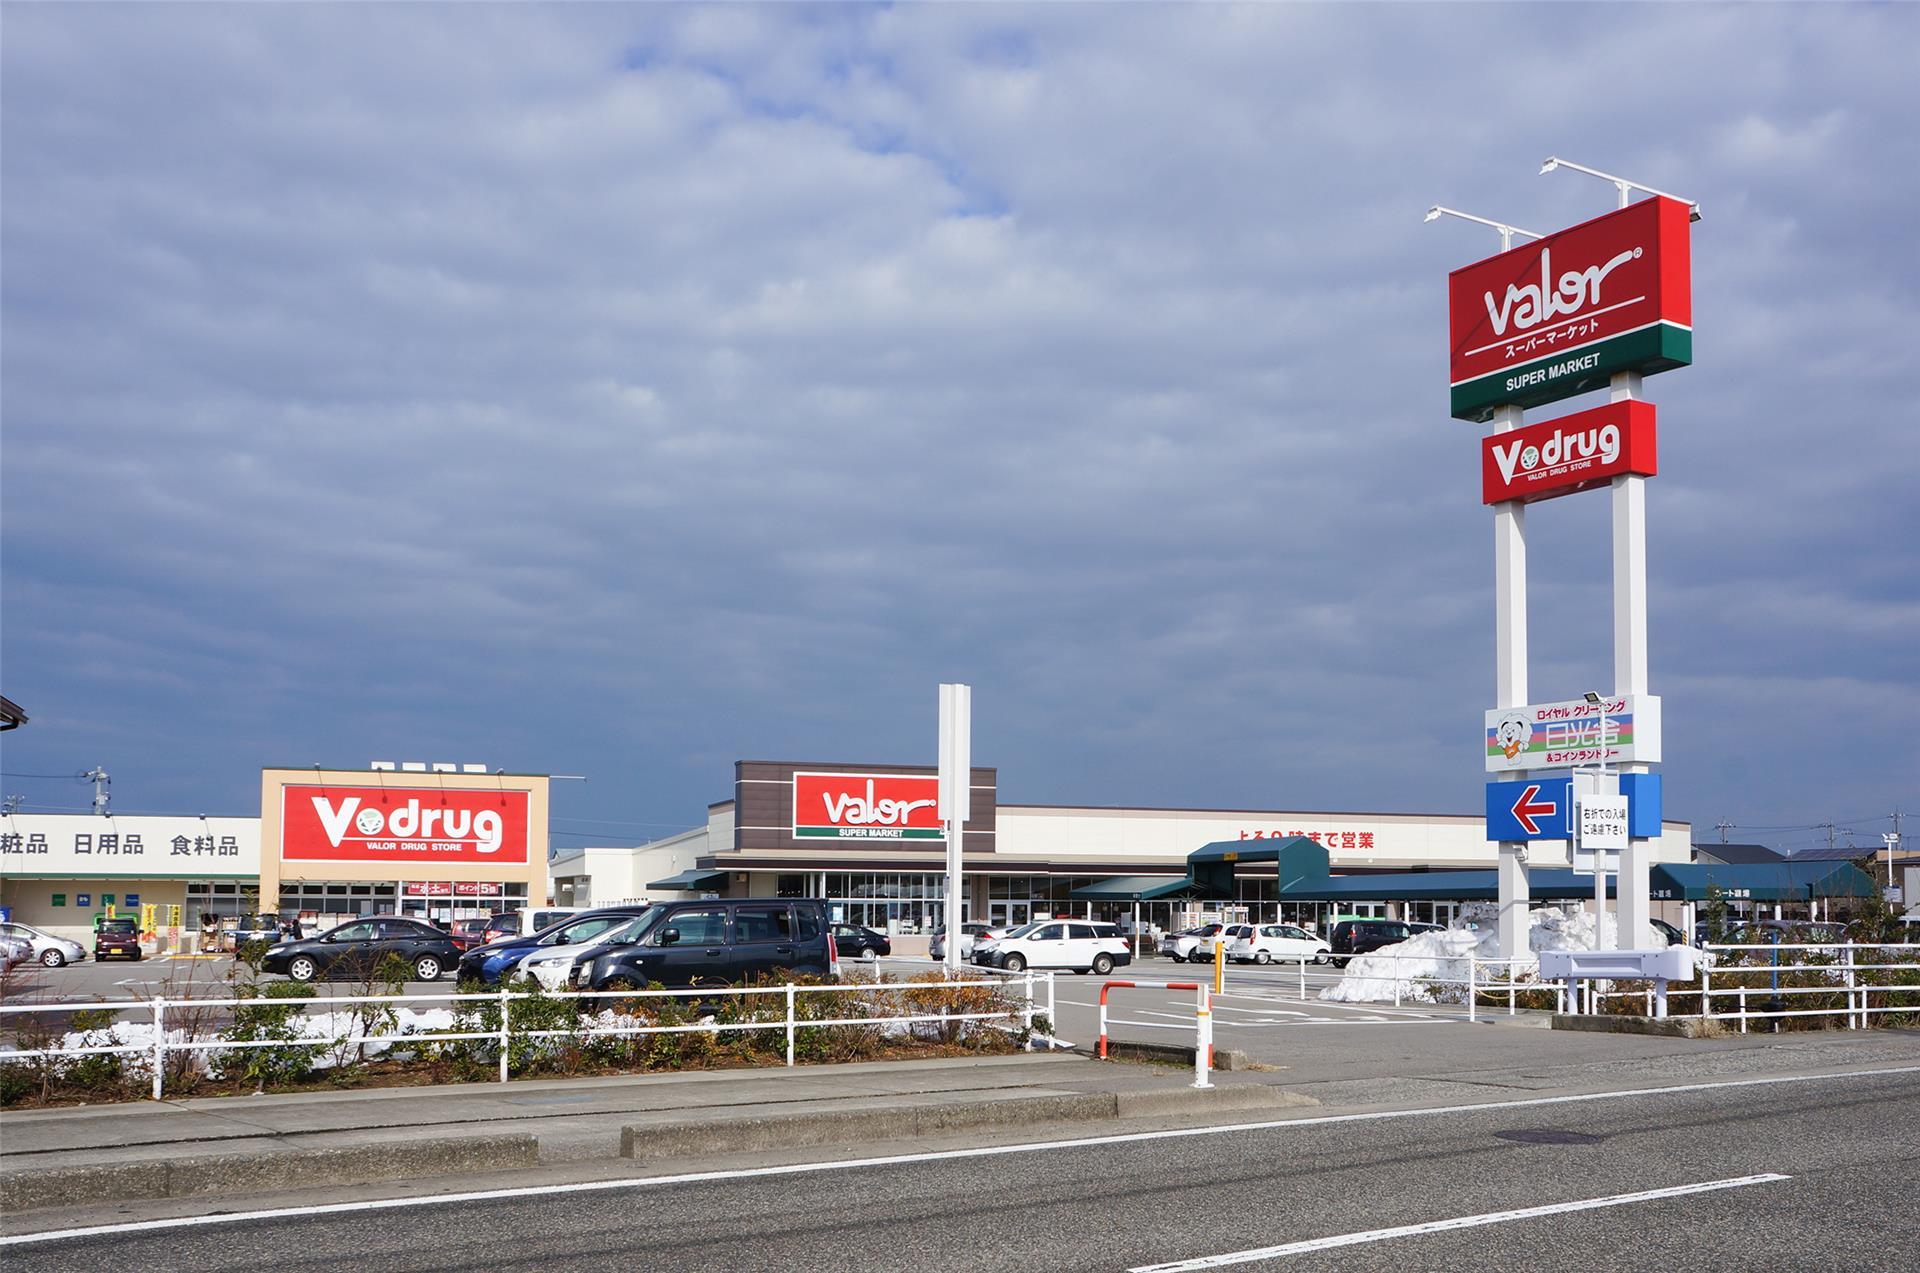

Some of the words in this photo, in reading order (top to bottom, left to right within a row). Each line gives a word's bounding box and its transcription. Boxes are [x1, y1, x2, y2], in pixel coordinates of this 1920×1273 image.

[1505, 317, 1599, 358] スーパーマーケット
[1506, 369, 1546, 392] SUPER
[1548, 353, 1601, 383] MARKET
[1527, 471, 1548, 481] VALOR
[1550, 466, 1568, 477] DRUG
[1570, 461, 1592, 471] STORE
[1537, 707, 1571, 720] ロイヤル
[1584, 808, 1626, 820] 右折での入場
[839, 828, 867, 838] SUPER
[869, 829, 904, 839] MARKET
[1, 833, 48, 855] 粧品
[75, 834, 144, 855] 日用品
[170, 834, 239, 856] 食料品
[366, 842, 397, 851] VALOR
[401, 842, 427, 851] DRUG
[431, 843, 463, 852] STORE
